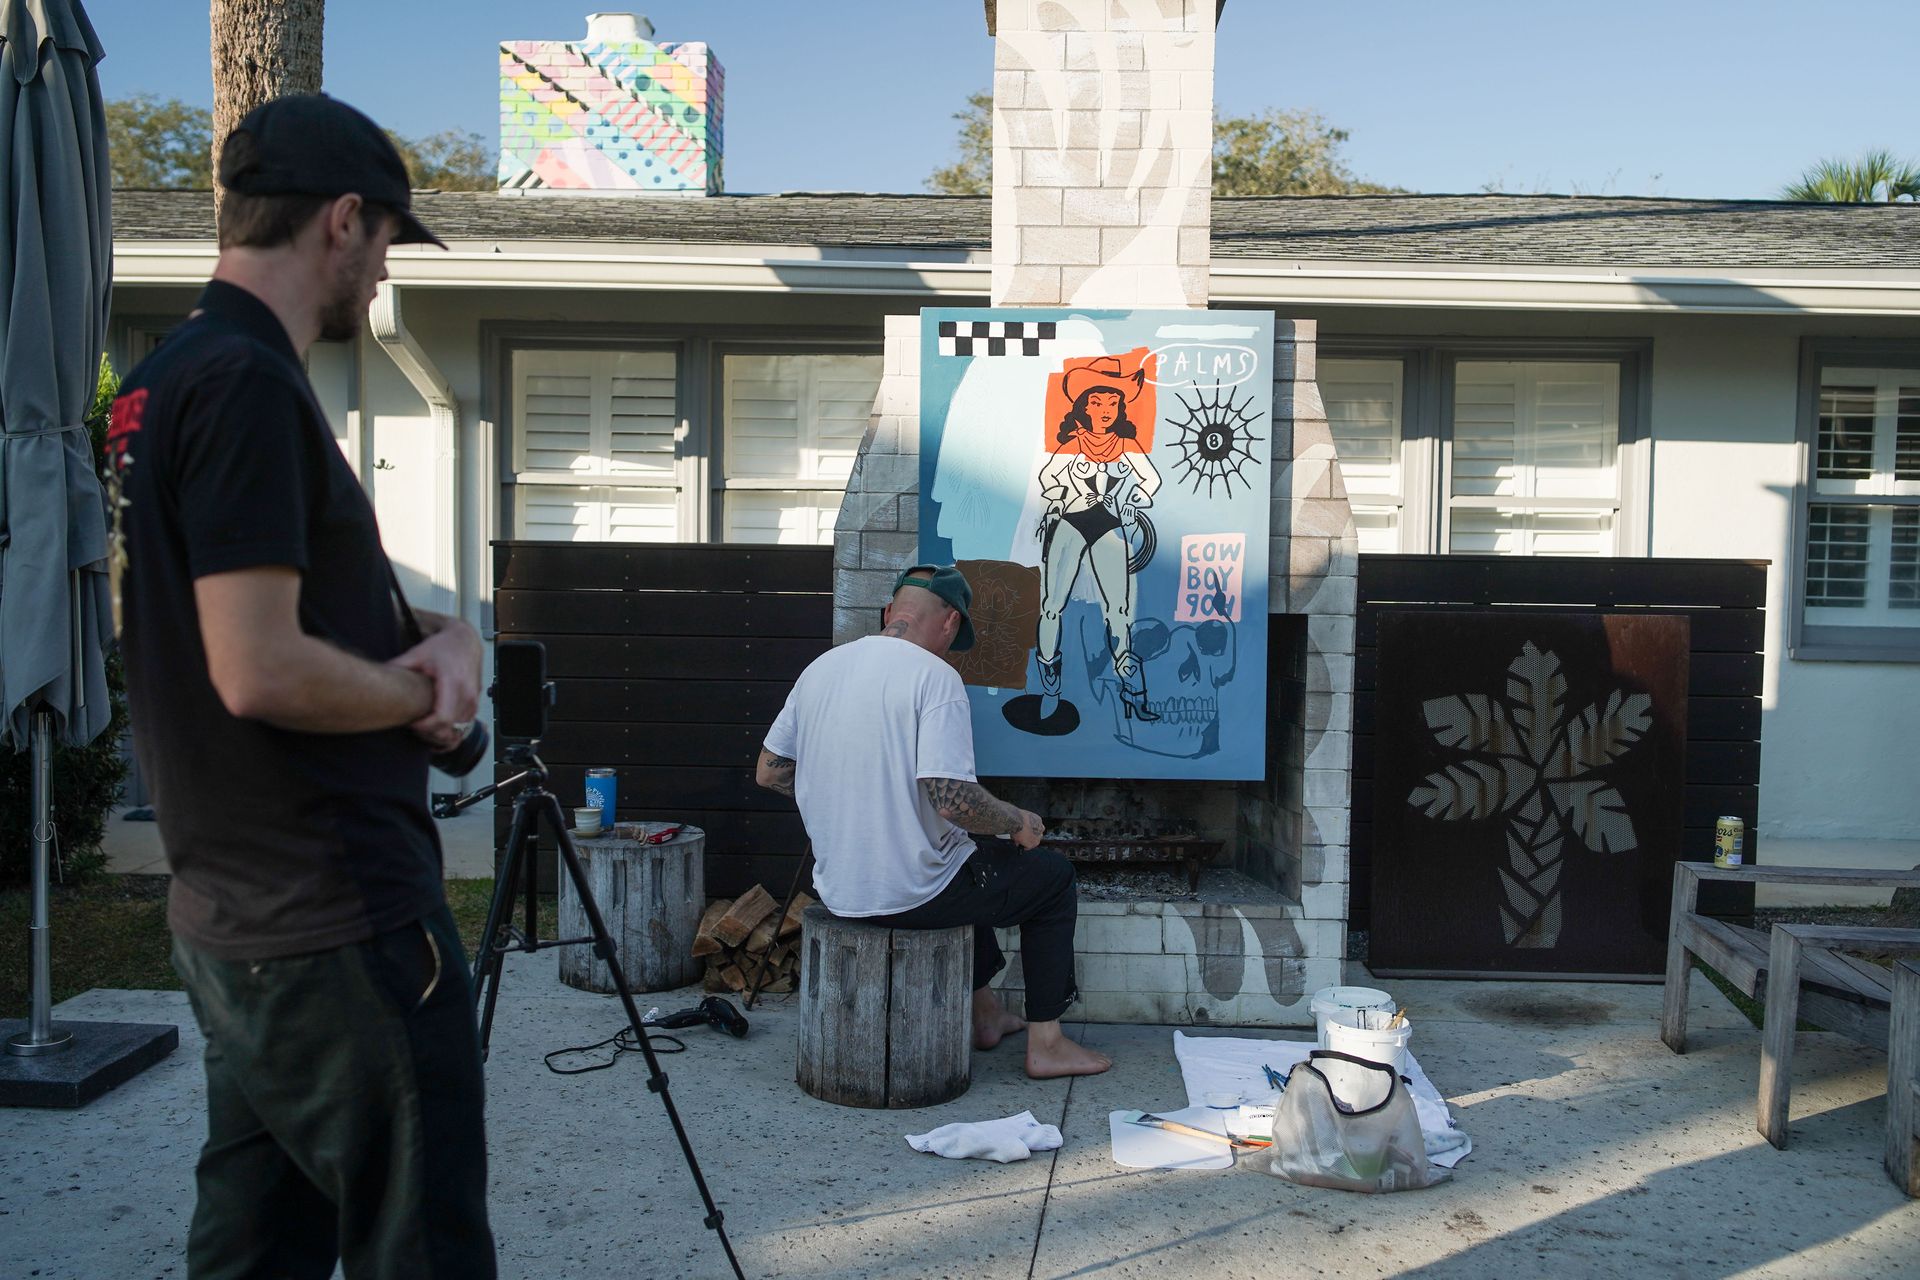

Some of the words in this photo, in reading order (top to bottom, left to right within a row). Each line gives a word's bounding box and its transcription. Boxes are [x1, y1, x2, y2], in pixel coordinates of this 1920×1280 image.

[1155, 351, 1250, 377] PALMS
[1209, 434, 1219, 448] 8
[1186, 542, 1242, 563] COW
[1187, 565, 1234, 591] BOY
